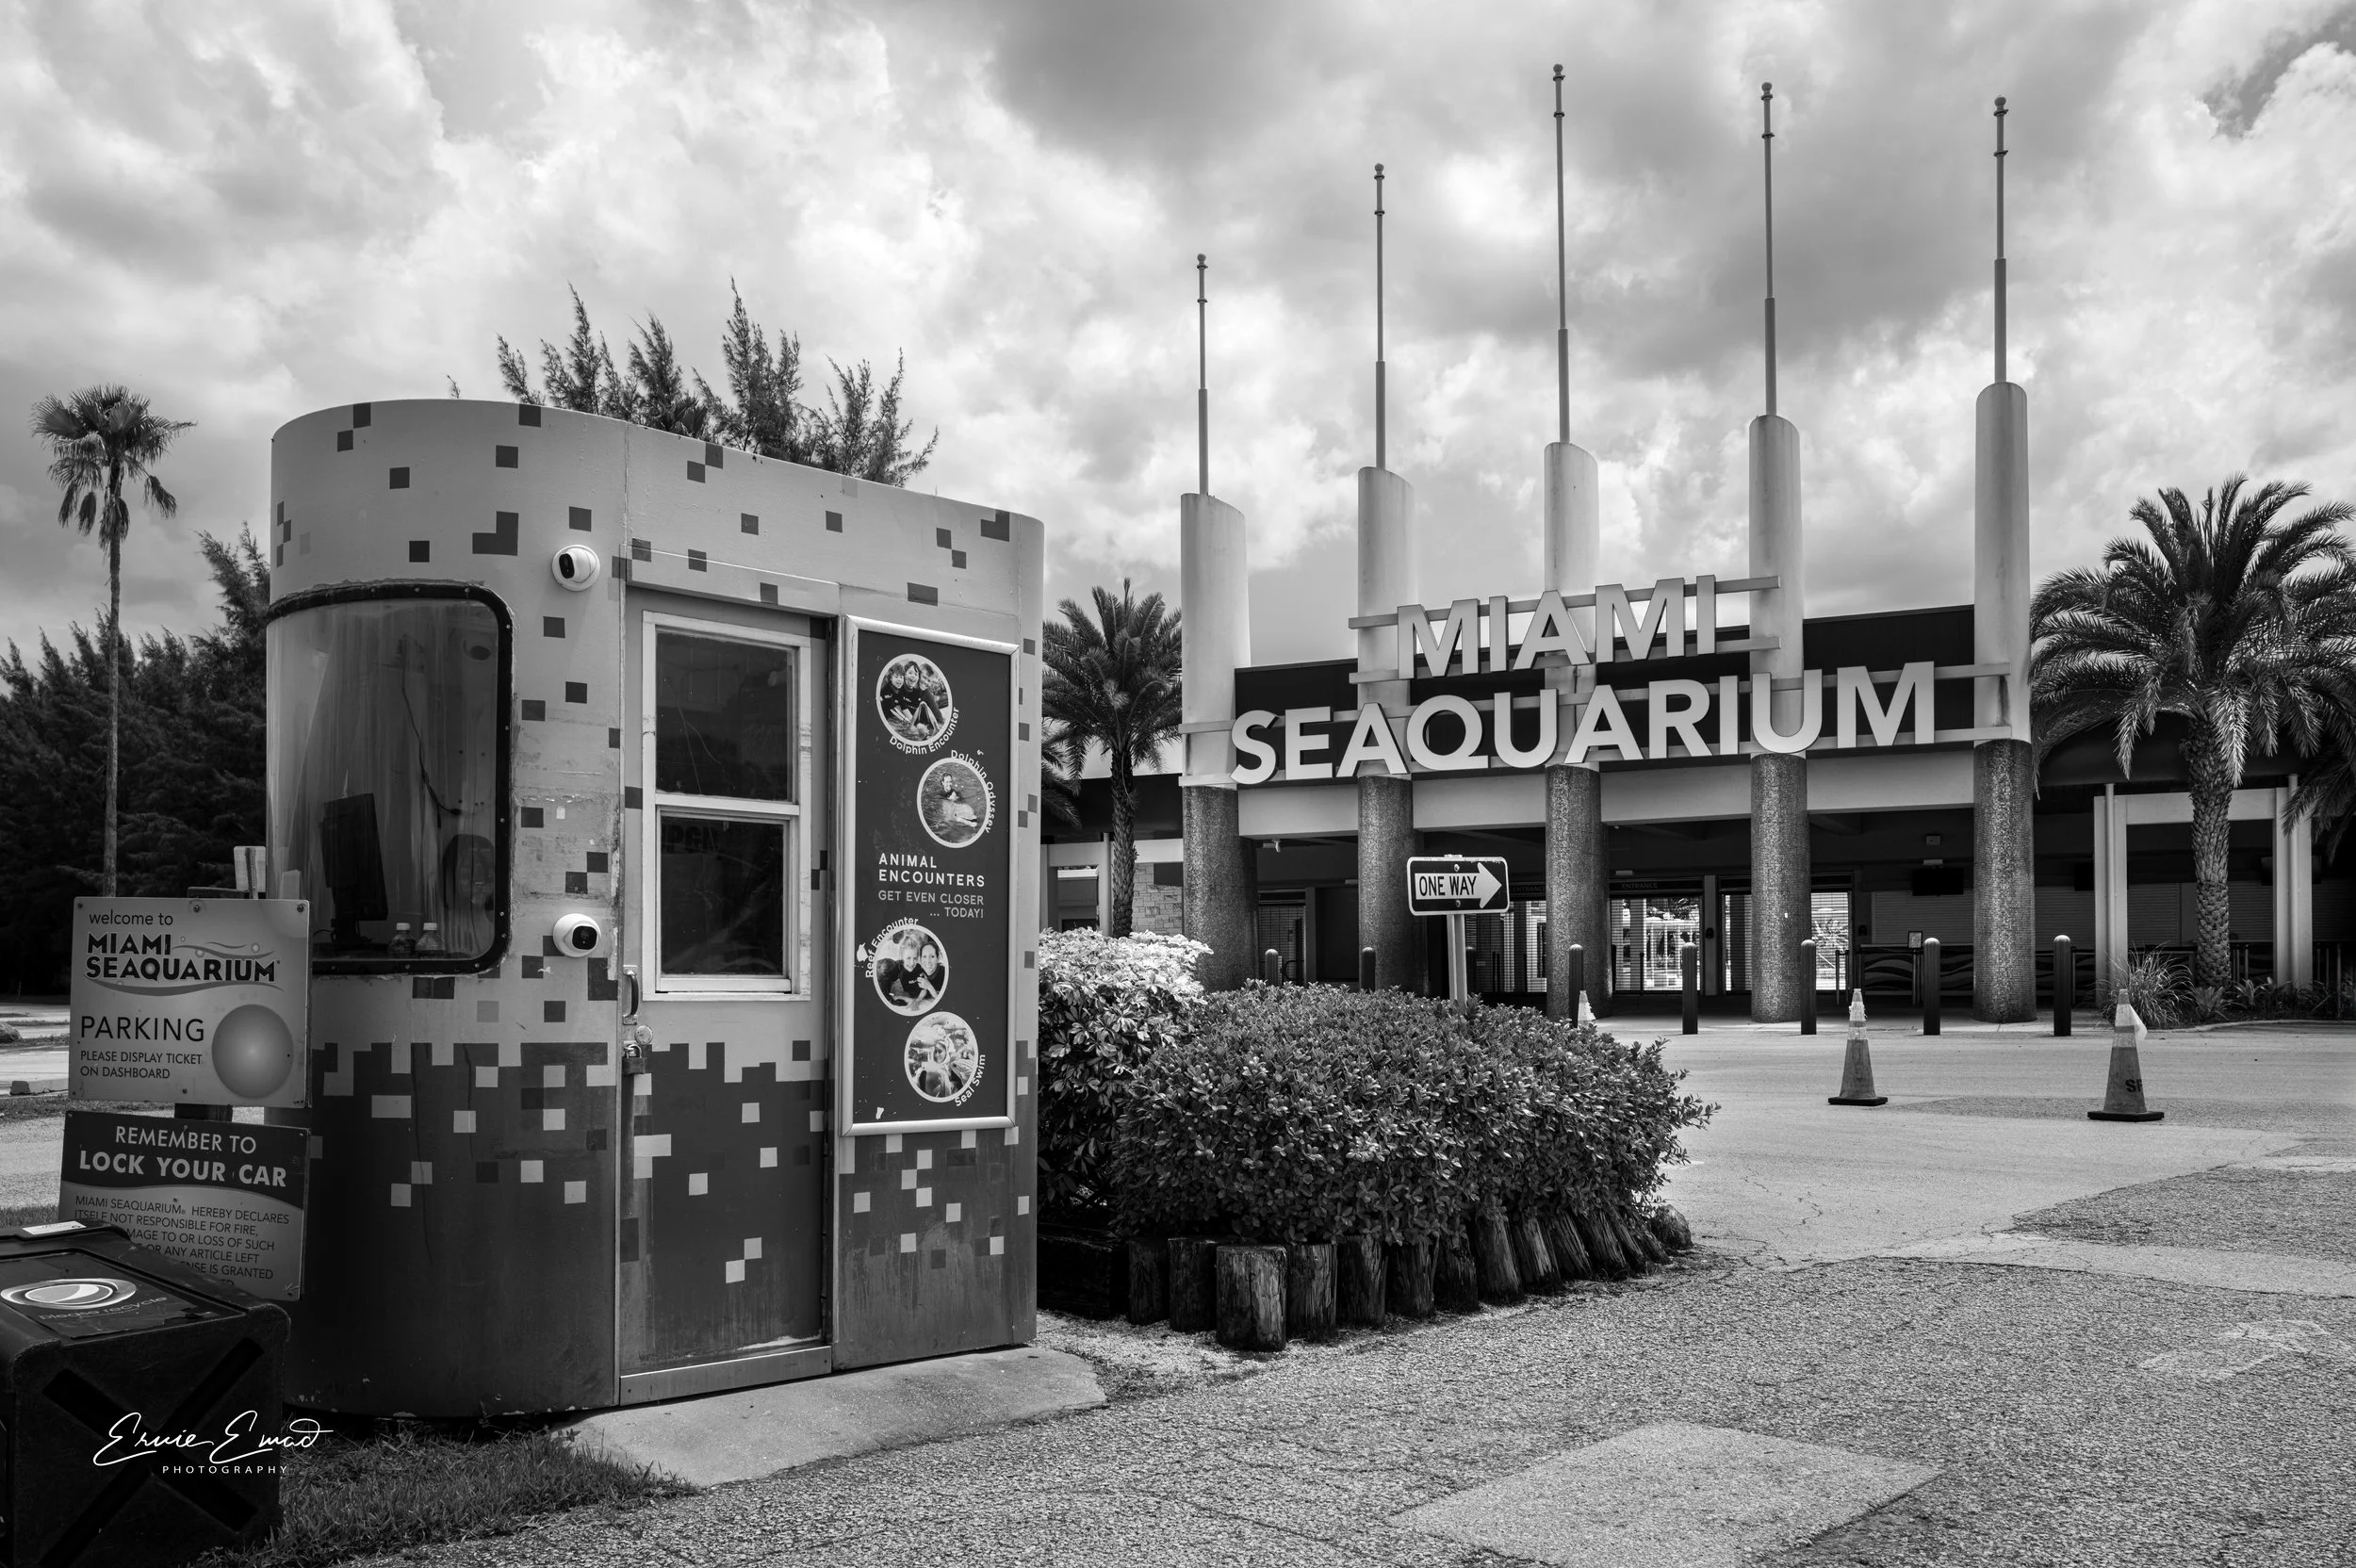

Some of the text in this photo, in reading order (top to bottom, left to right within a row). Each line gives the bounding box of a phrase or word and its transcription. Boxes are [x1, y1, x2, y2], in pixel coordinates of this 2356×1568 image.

[1397, 575, 1717, 680] MIAMI
[890, 708, 959, 755] Dolphin Encounter
[1229, 661, 1936, 786] SEAQUARIUM
[951, 749, 997, 834] Dolphin Odyssey
[878, 853, 937, 869] ANIMAL
[878, 870, 985, 887] ENCOUNTERS
[1418, 875, 1477, 897] ONE WAY
[878, 890, 984, 906] GET EVEN CLOSER
[89, 909, 173, 925] welcome to
[944, 906, 984, 919] TODAY!
[87, 932, 172, 956] MIAMI
[865, 916, 919, 978] Reef Encounter
[86, 956, 276, 982] SEAQUARIUM
[80, 1015, 205, 1042] PARKING
[80, 1051, 203, 1065] PLEASE DISPLAY TICKET
[80, 1066, 171, 1079] ON DASHBOARD
[955, 1054, 986, 1106] Seal Swim
[115, 1126, 256, 1154] REMEMBER TO
[79, 1150, 286, 1187] LOCK YOUR CAR
[75, 1195, 108, 1208] MIAMI
[191, 1206, 233, 1219] HEREBY
[235, 1210, 290, 1225] DECLARES
[109, 1212, 133, 1225] NOT
[137, 1215, 207, 1231] RESPONSIBLE
[209, 1221, 232, 1233] FOR
[234, 1224, 259, 1237] FIRE,
[126, 1228, 275, 1251] MAGE TO OR LOSS OF SUCH
[164, 1246, 188, 1257] ANY
[189, 1249, 233, 1263] ARTICLE
[235, 1252, 260, 1265] LEFT
[209, 1264, 219, 1274] IS
[221, 1266, 273, 1280] GRANTED
[39, 1310, 99, 1319] please
